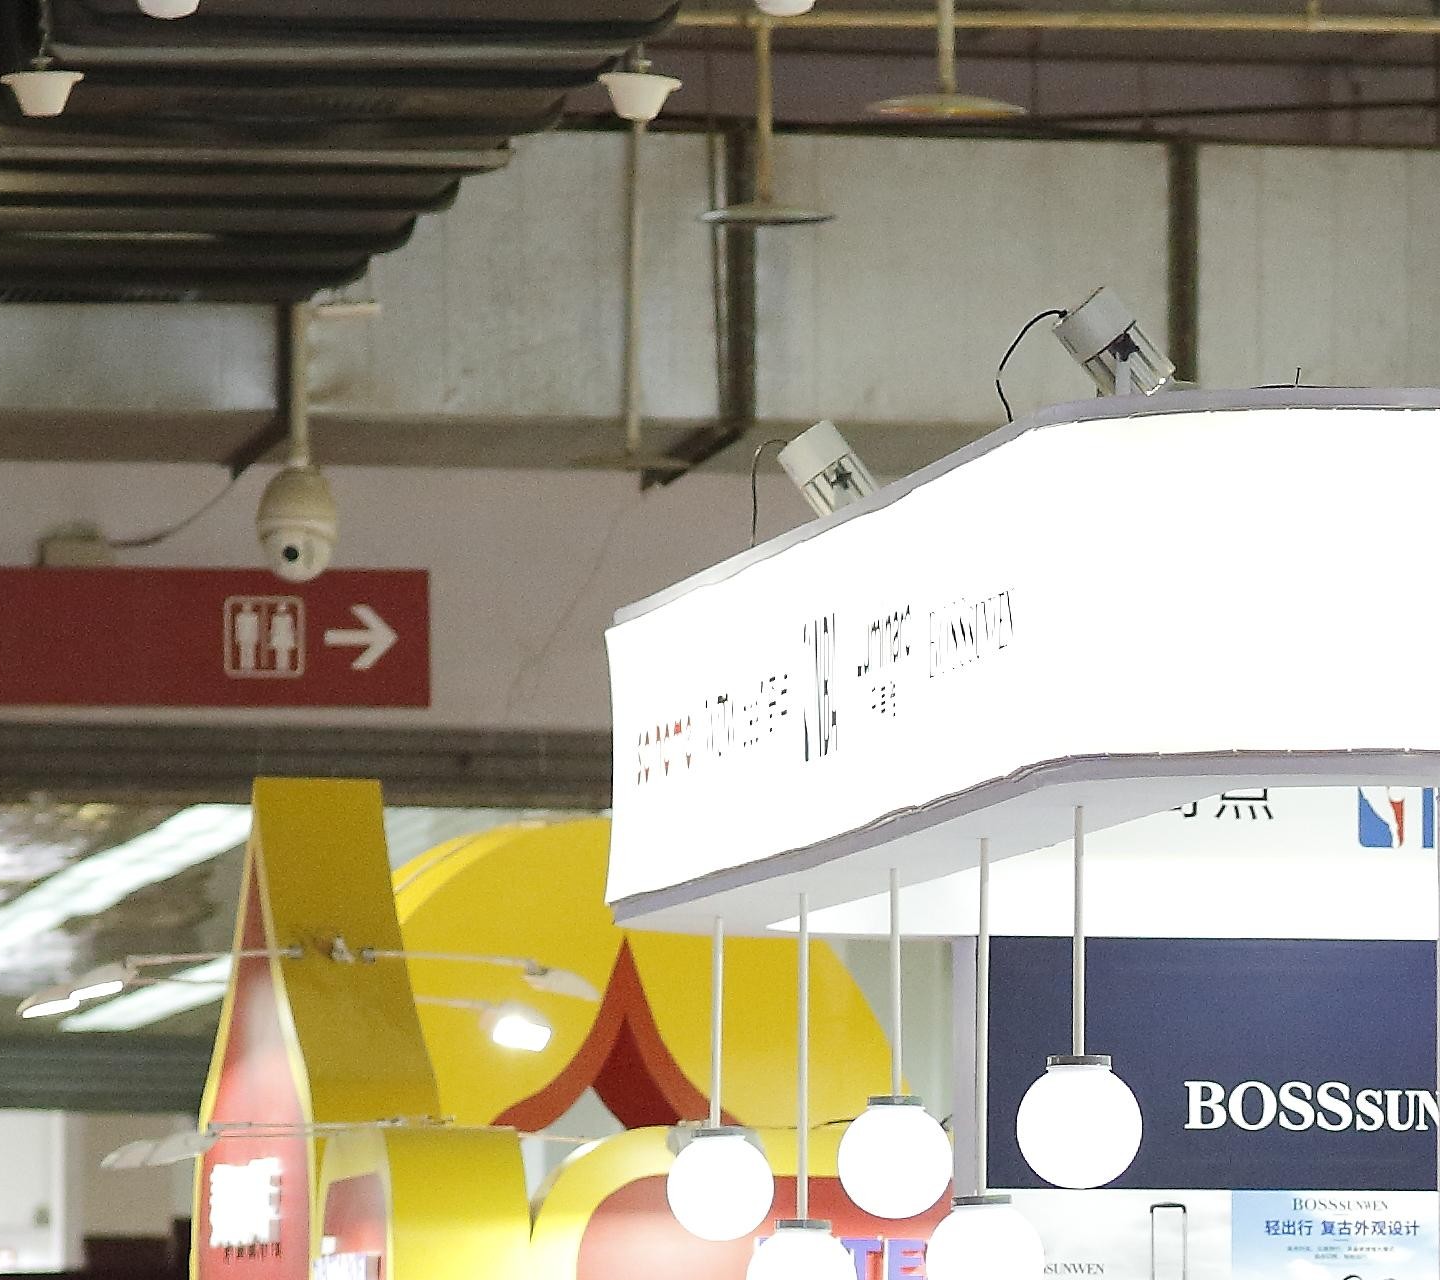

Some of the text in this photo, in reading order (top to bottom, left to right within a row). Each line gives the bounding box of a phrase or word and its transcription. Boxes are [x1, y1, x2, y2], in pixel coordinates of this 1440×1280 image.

[1265, 1219, 1421, 1237] 轻出行 复古外观设计
